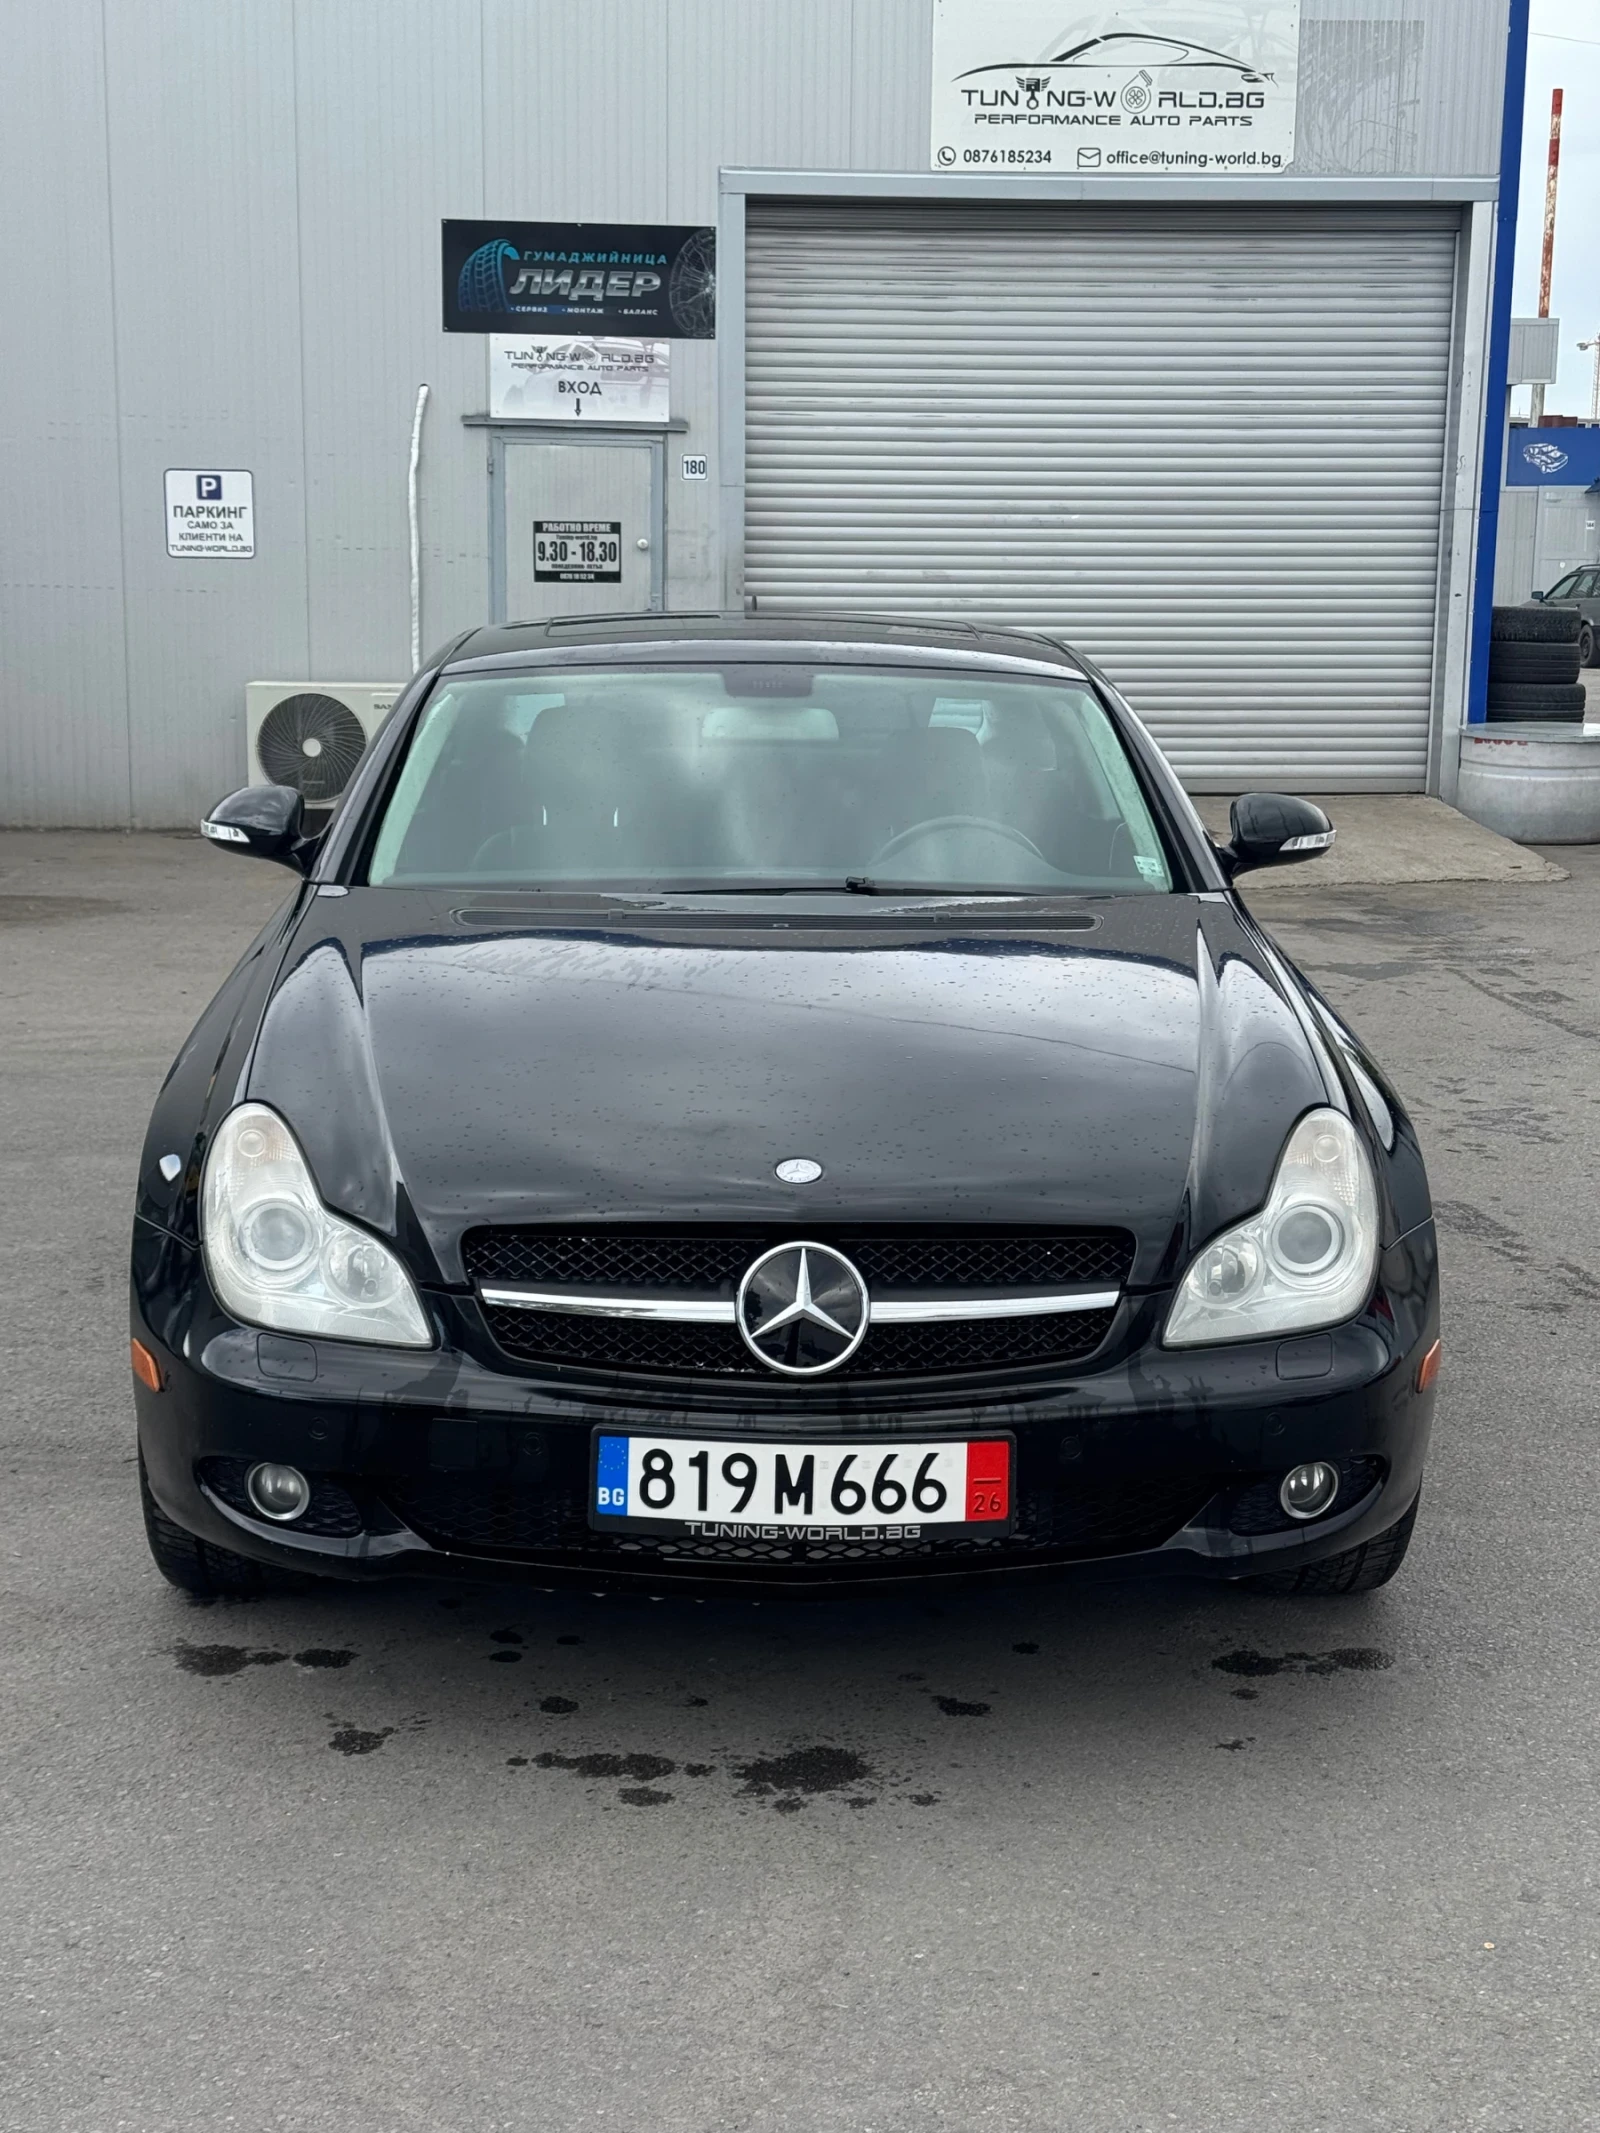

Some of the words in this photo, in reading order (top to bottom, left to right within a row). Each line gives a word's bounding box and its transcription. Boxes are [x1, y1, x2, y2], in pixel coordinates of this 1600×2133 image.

[974, 113, 1121, 126] PERFORMANCE
[1130, 114, 1180, 126] AUTO
[1189, 114, 1253, 127] PARTS
[963, 149, 1052, 164] 0876185234
[1106, 150, 1282, 168] office@tuning-world.bg
[523, 250, 668, 266] ГУМАДЖИЙНИЦА
[509, 268, 662, 302] ЛИДЕР
[515, 305, 548, 313] СЕРВИЗ
[511, 362, 584, 371] PERFORMANCE
[558, 380, 602, 395] ВХОД
[683, 460, 706, 475] 180
[201, 477, 217, 498] P
[173, 505, 248, 519] ПАРКИНГ
[187, 520, 217, 530] САМО
[220, 521, 234, 530] ЗА
[542, 522, 582, 532] РАБОТНО
[583, 523, 611, 533] ВРЕМЕ
[178, 532, 226, 541] КЛИЕНТИ
[228, 533, 244, 542] НА
[537, 541, 568, 562] 9.30
[579, 541, 617, 563] 18.30
[598, 1486, 625, 1506] BG
[973, 1491, 1002, 1513] 26
[684, 1521, 921, 1540] TUNING-WORLD.BG
